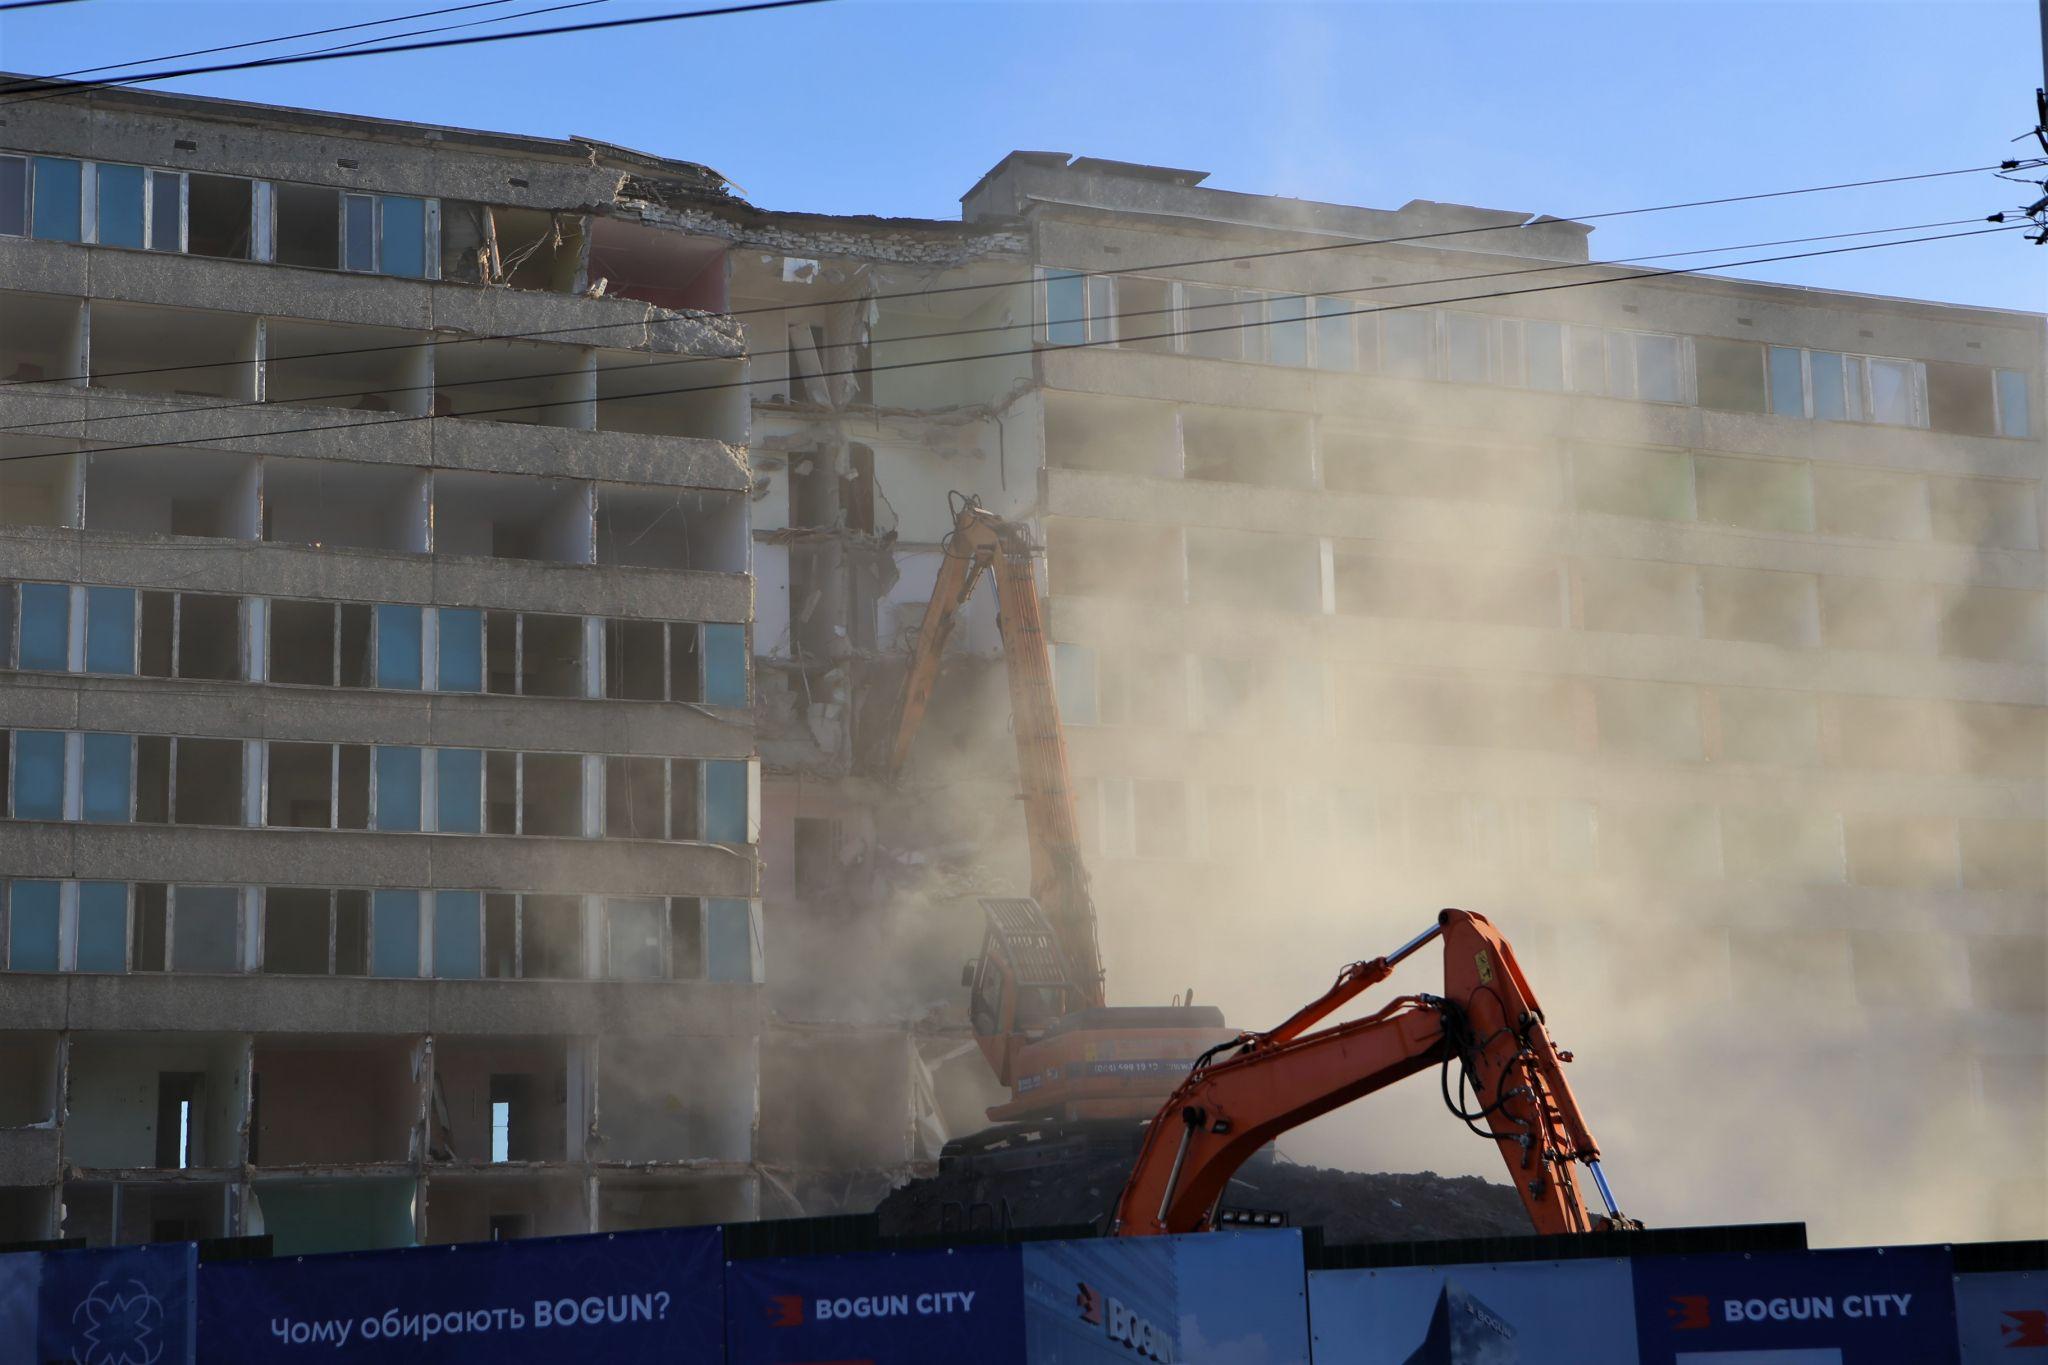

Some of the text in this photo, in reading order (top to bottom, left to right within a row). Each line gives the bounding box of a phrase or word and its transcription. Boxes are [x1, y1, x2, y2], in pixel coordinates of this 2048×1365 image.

[271, 1291, 671, 1347] Чому обирають BOGUN?
[816, 1290, 975, 1319] BOGUN CITY
[1724, 1293, 1913, 1322] BOGUN CITY
